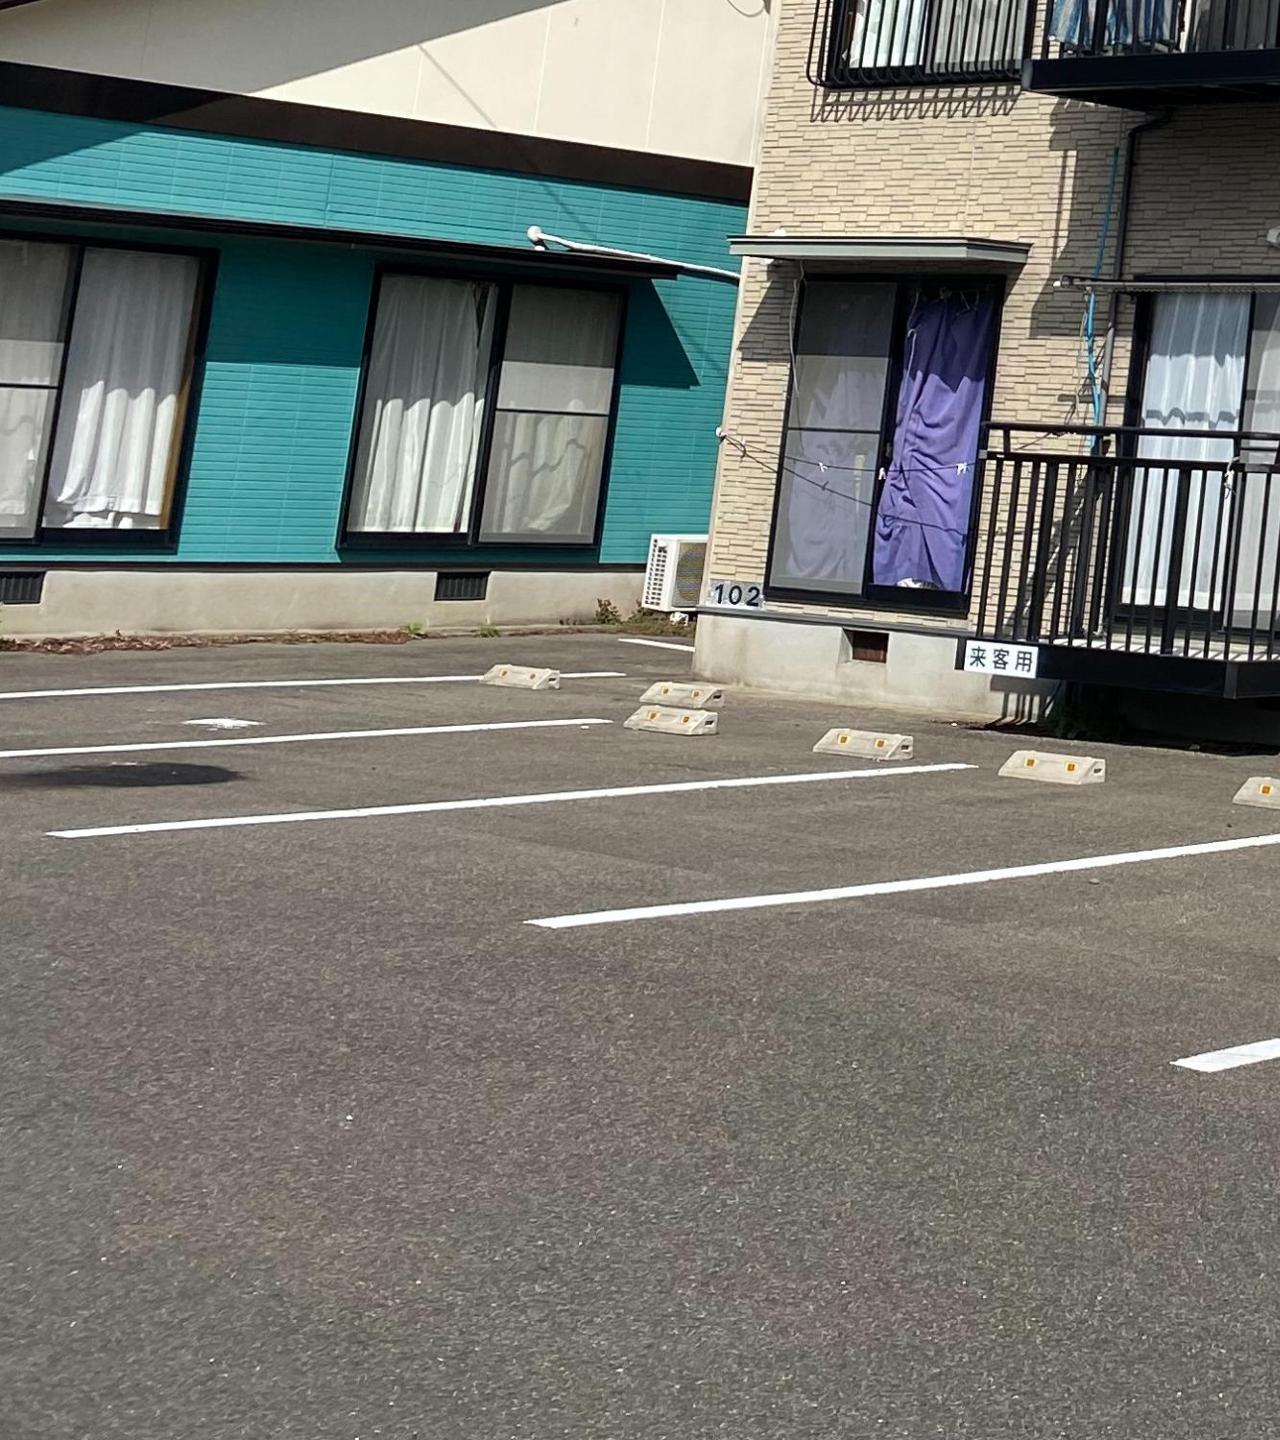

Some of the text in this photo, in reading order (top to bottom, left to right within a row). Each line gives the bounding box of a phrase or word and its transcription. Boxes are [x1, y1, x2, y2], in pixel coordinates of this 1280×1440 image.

[715, 584, 760, 607] 102
[969, 645, 1033, 673] 来客用
